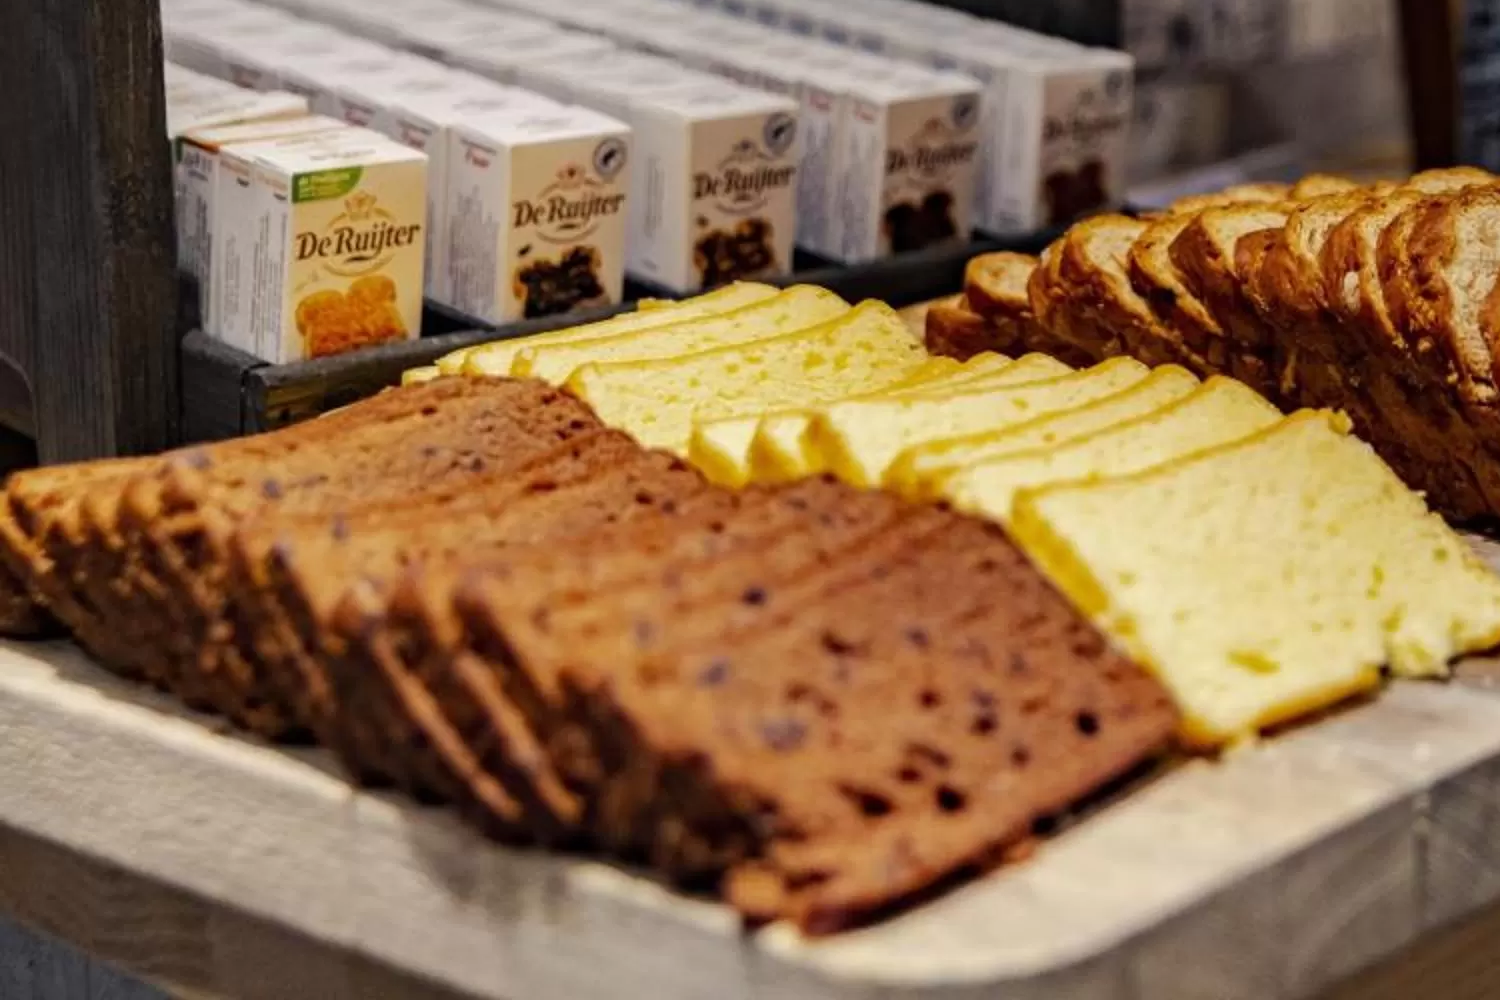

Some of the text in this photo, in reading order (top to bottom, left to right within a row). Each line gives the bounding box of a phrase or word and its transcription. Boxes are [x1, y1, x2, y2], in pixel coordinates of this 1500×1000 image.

[692, 172, 720, 199] De
[512, 192, 626, 231] De Ruijter
[296, 221, 421, 263] De Ruijter
